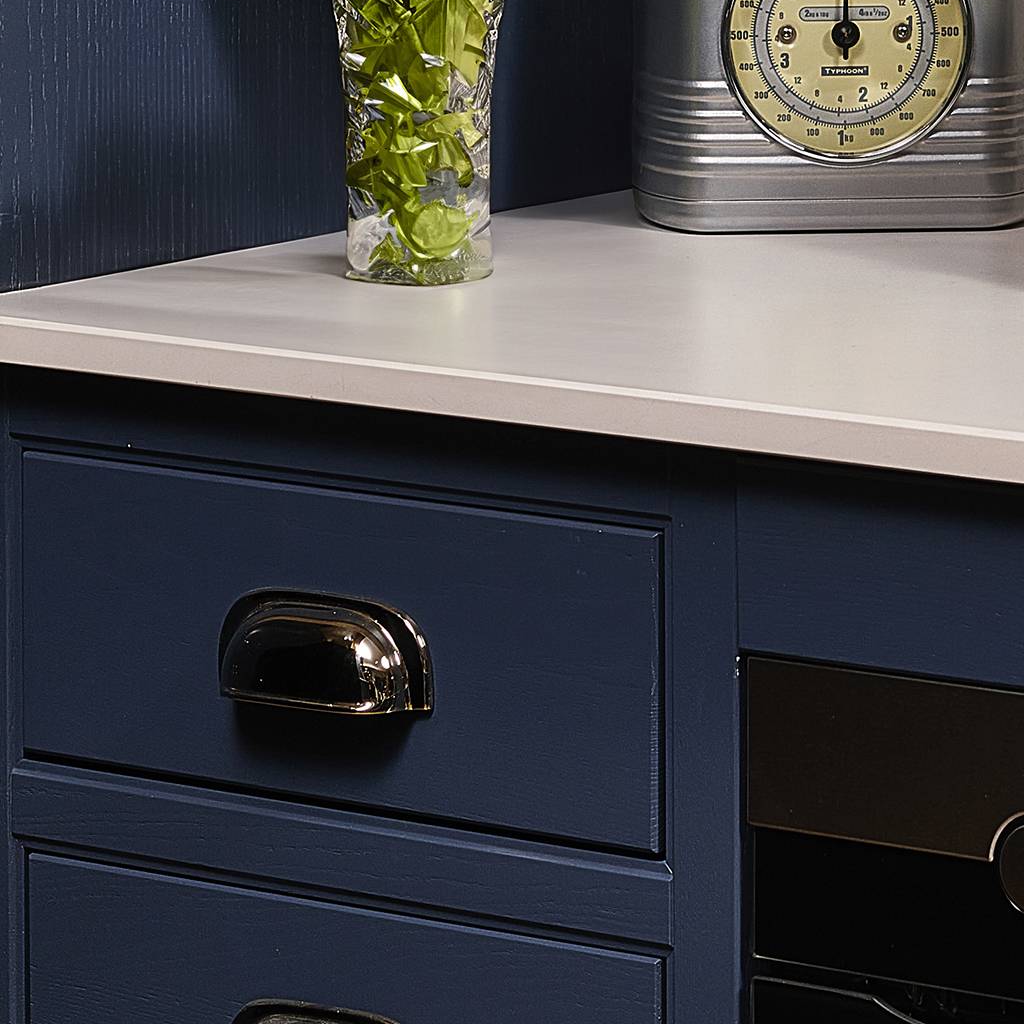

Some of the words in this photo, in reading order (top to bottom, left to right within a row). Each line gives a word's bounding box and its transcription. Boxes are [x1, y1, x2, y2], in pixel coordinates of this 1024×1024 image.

[778, 11, 784, 20] 8
[730, 30, 749, 40] 500
[941, 27, 959, 36] 500
[906, 43, 912, 51] 4
[780, 52, 790, 69] 3
[739, 63, 754, 71] 400
[897, 64, 903, 73] 8
[793, 77, 802, 85] 12
[880, 82, 888, 90] 12
[754, 91, 769, 99] 300
[815, 89, 820, 97] 8
[858, 87, 868, 103] 2
[922, 89, 936, 97] 700
[837, 95, 843, 103] 4
[777, 114, 791, 122] 200
[806, 128, 820, 136] 100
